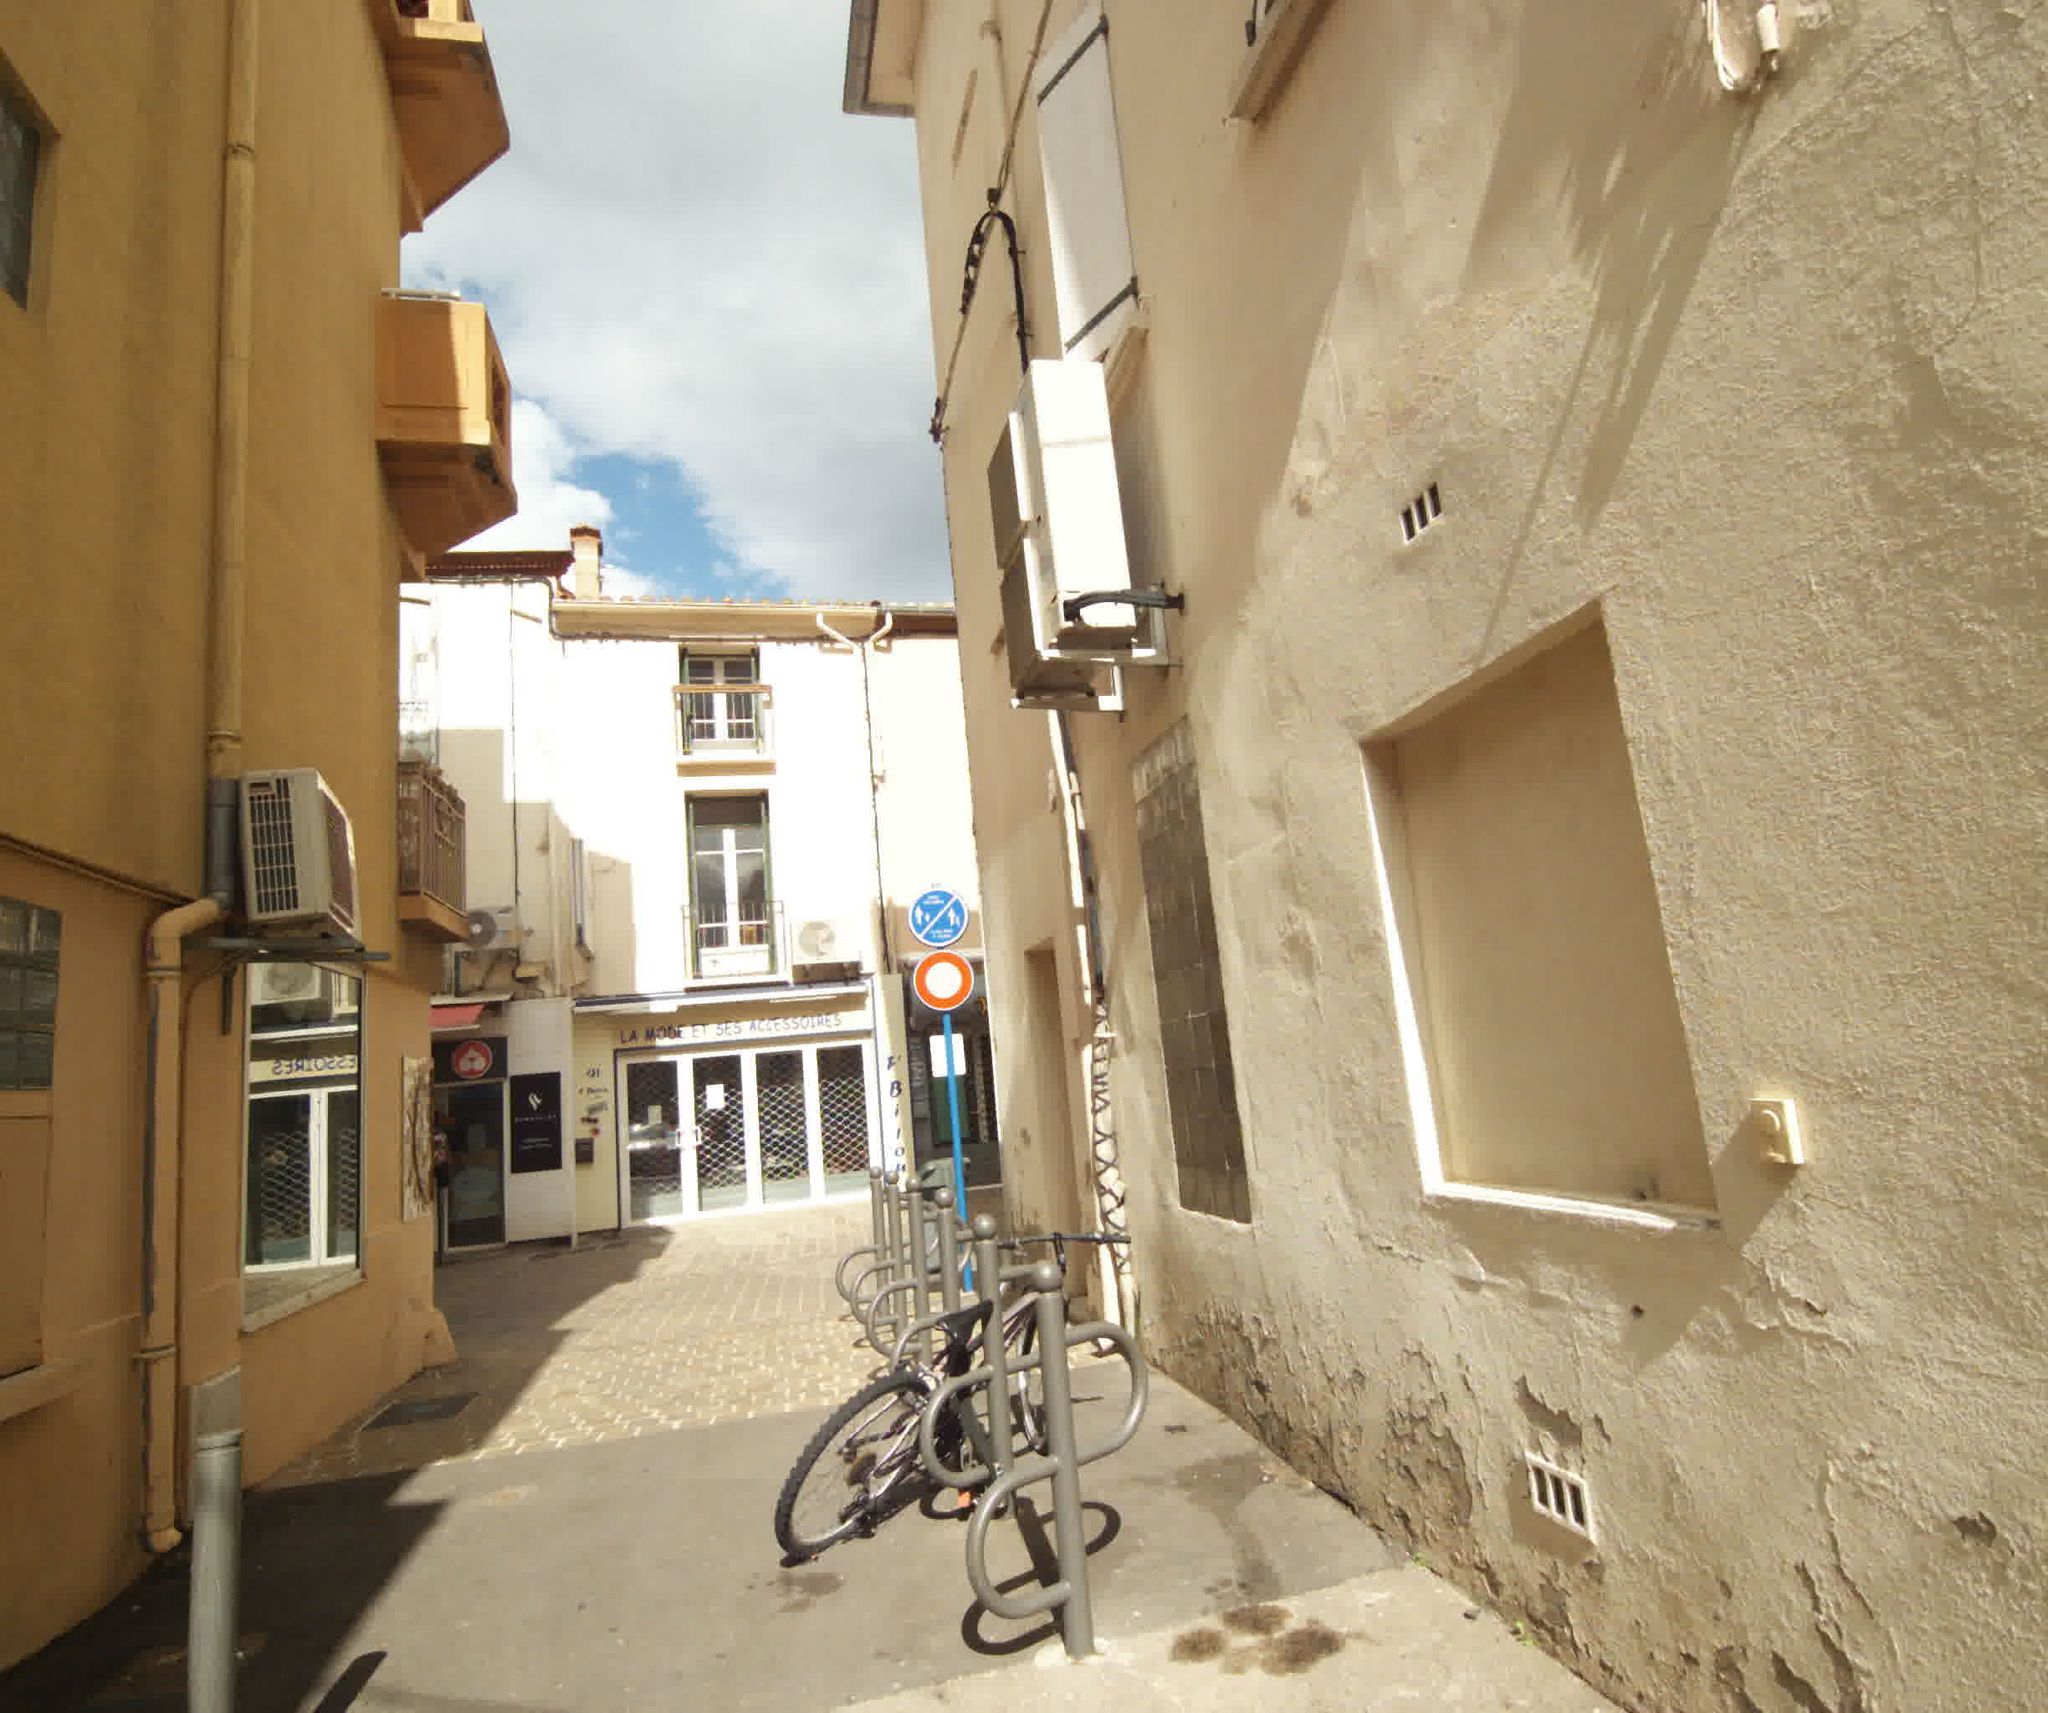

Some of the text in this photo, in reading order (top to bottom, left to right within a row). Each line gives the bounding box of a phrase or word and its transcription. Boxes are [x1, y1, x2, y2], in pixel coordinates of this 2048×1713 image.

[619, 1012, 842, 1045] LA MODE ET SES ACCESSOIRES
